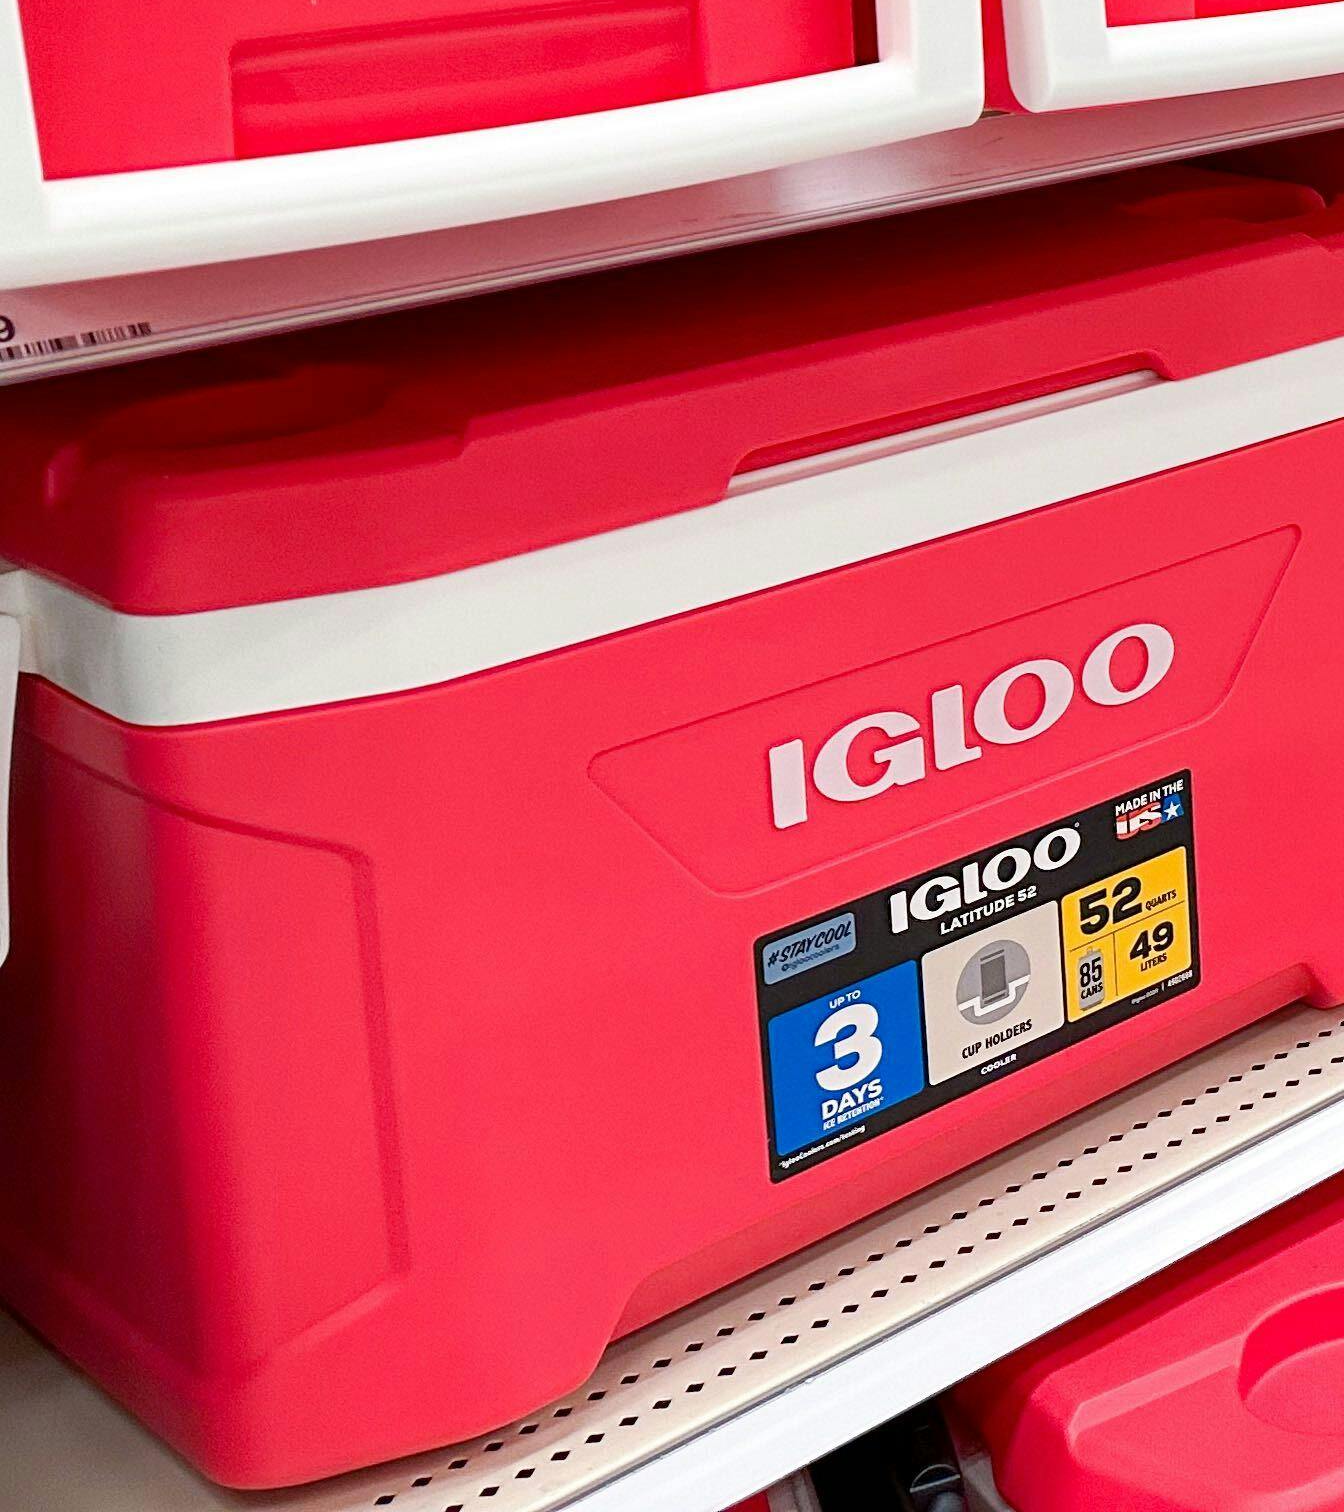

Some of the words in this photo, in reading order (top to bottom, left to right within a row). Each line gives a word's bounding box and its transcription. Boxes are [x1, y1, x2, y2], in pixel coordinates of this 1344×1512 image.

[769, 622, 1175, 829] IGLOO
[1115, 794, 1147, 816] MADE
[1150, 788, 1161, 802] IN
[1162, 779, 1184, 796] THE
[890, 827, 1081, 934] IGLOO
[1145, 889, 1177, 911] QUARTS
[940, 894, 1015, 935] LATITUDE
[1017, 885, 1037, 903] 52
[1079, 876, 1142, 935] 52
[768, 921, 851, 968] #STAYCOOL
[1129, 921, 1174, 961] 49
[1080, 957, 1102, 987] 85
[1140, 952, 1168, 972] LITERS
[829, 996, 844, 1009] UP
[846, 990, 861, 1002] TO
[1080, 983, 1104, 999] CANS
[814, 1003, 883, 1091] 3
[962, 1042, 982, 1059] CUP
[985, 1019, 1033, 1049] HOLDERS
[981, 1054, 1017, 1075] COOLER
[822, 1078, 883, 1121] DAYS
